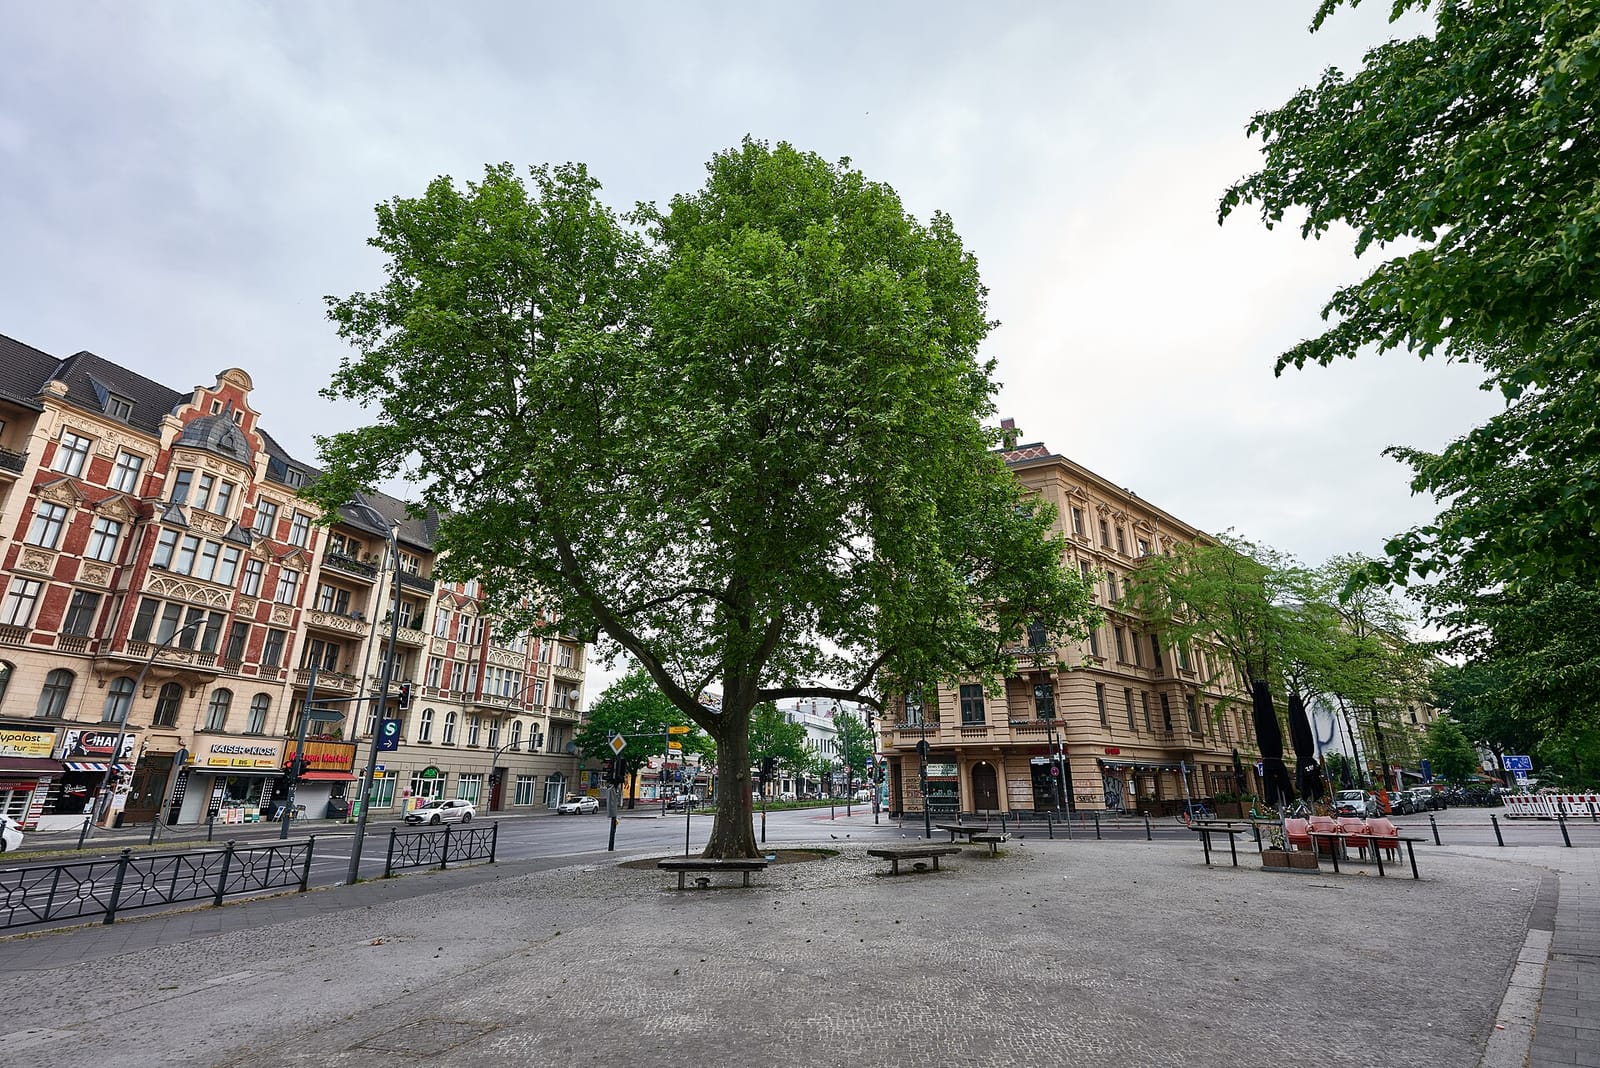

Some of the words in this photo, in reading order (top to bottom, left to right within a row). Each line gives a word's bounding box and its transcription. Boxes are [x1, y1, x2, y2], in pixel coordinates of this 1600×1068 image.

[384, 722, 398, 736] S
[0, 732, 42, 743] ypalast
[211, 744, 244, 754] KAISER
[251, 746, 277, 756] KIOSK
